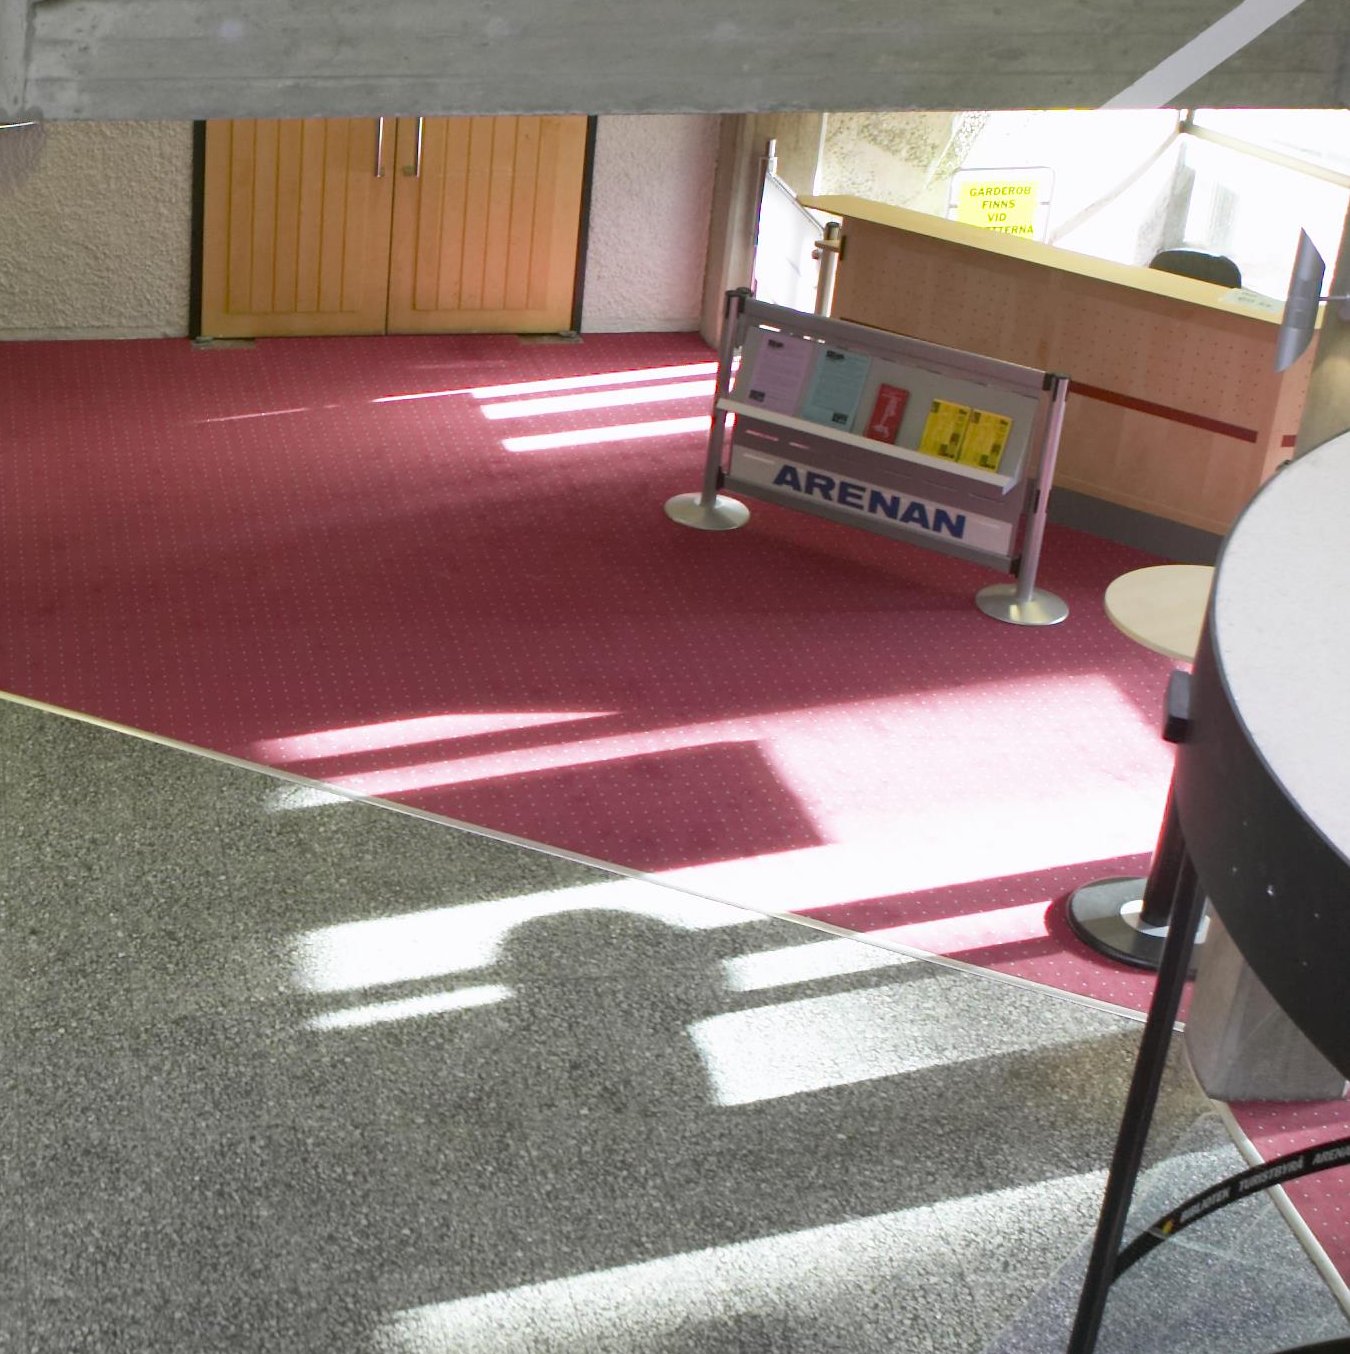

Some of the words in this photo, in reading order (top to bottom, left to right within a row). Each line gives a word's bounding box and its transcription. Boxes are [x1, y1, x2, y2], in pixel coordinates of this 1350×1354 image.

[969, 186, 1032, 197] GARDEROB
[981, 199, 1016, 210] FINNS
[987, 212, 1007, 223] VID
[772, 464, 967, 539] ARENAN
